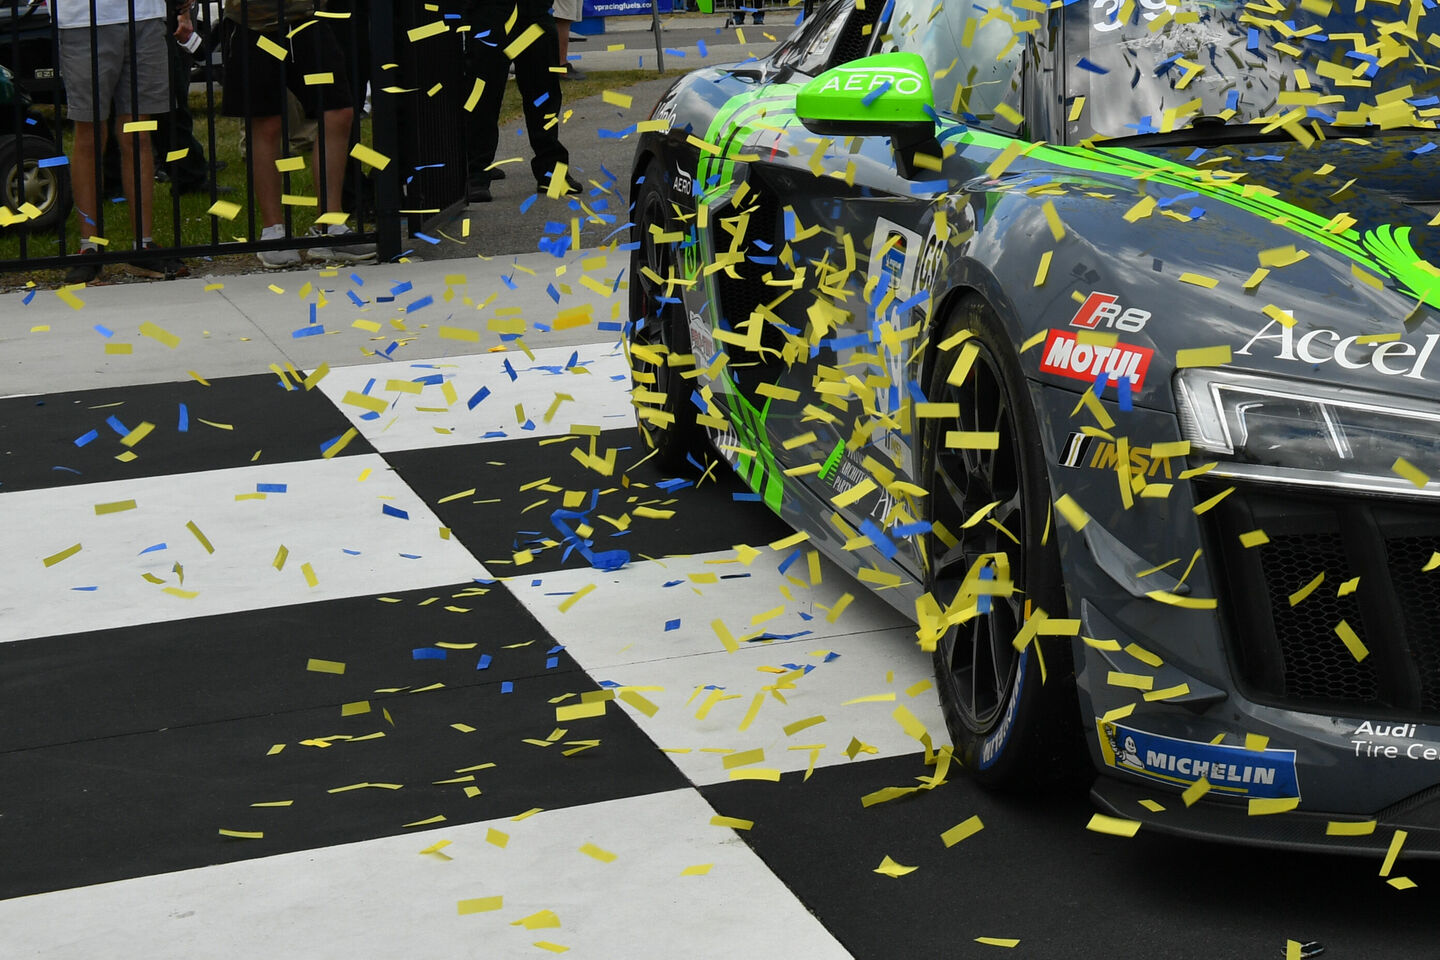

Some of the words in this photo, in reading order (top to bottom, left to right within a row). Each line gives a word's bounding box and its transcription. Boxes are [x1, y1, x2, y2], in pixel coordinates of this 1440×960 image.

[594, 2, 652, 11] vpracingfuels.co
[818, 74, 912, 95] AERO
[672, 176, 692, 195] AERO
[1087, 302, 1152, 333] R8
[1233, 309, 1440, 380] Accel
[1045, 337, 1143, 384] MOTUL
[1089, 442, 1173, 479] IMSA
[1354, 721, 1417, 738] Audi
[1351, 740, 1399, 759] Tire
[1146, 750, 1276, 785] MICHELIN
